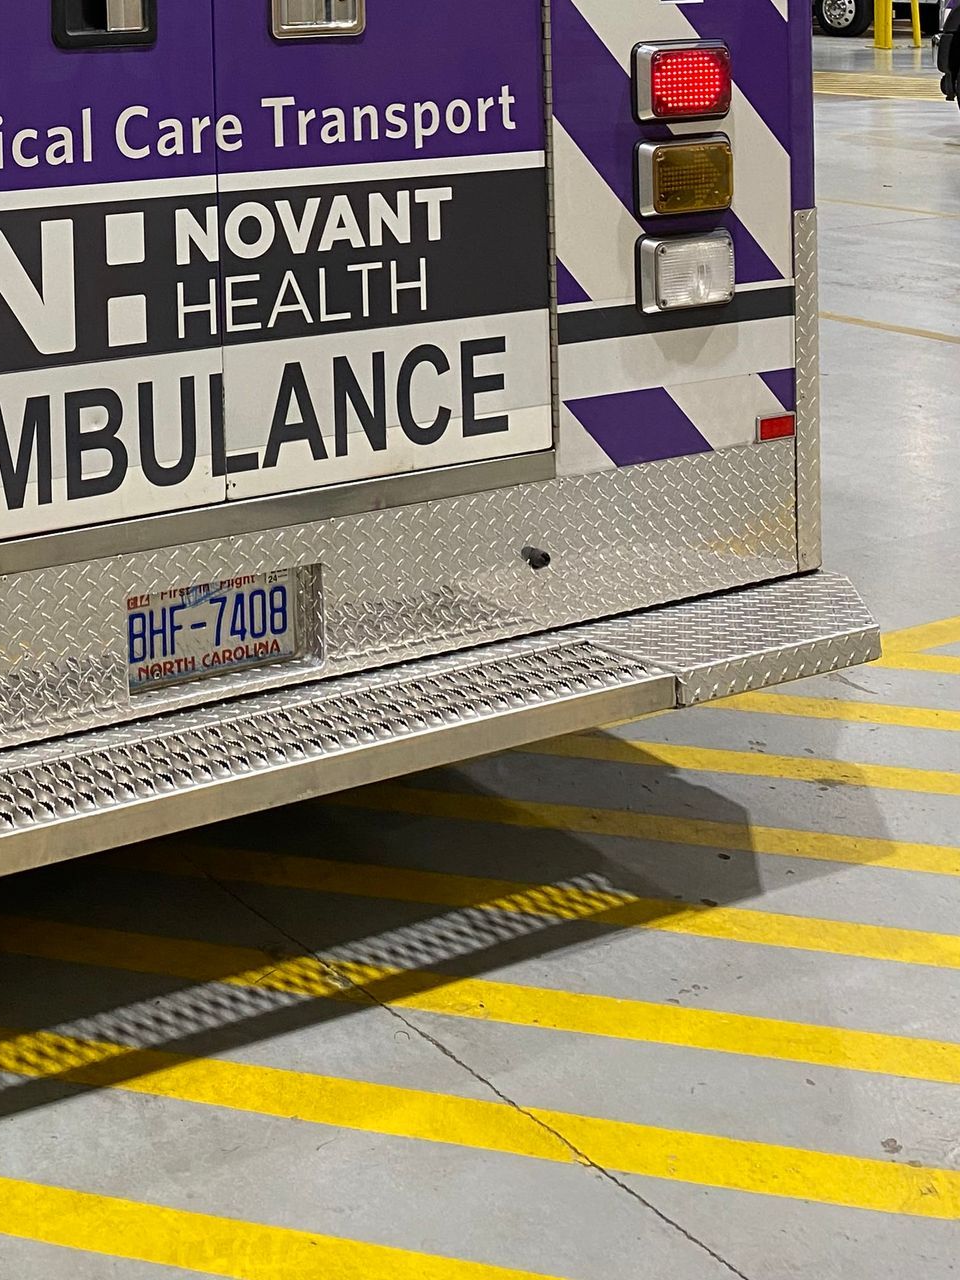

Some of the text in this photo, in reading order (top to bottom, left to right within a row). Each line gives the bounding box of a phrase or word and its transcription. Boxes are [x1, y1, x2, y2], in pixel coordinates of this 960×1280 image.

[114, 105, 243, 160] Care
[260, 83, 518, 149] Transport
[175, 186, 453, 265] NOVANT
[176, 256, 430, 339] HEALTH
[128, 585, 288, 664] BHF-7408
[138, 638, 281, 681] NORTH CAROLINA
